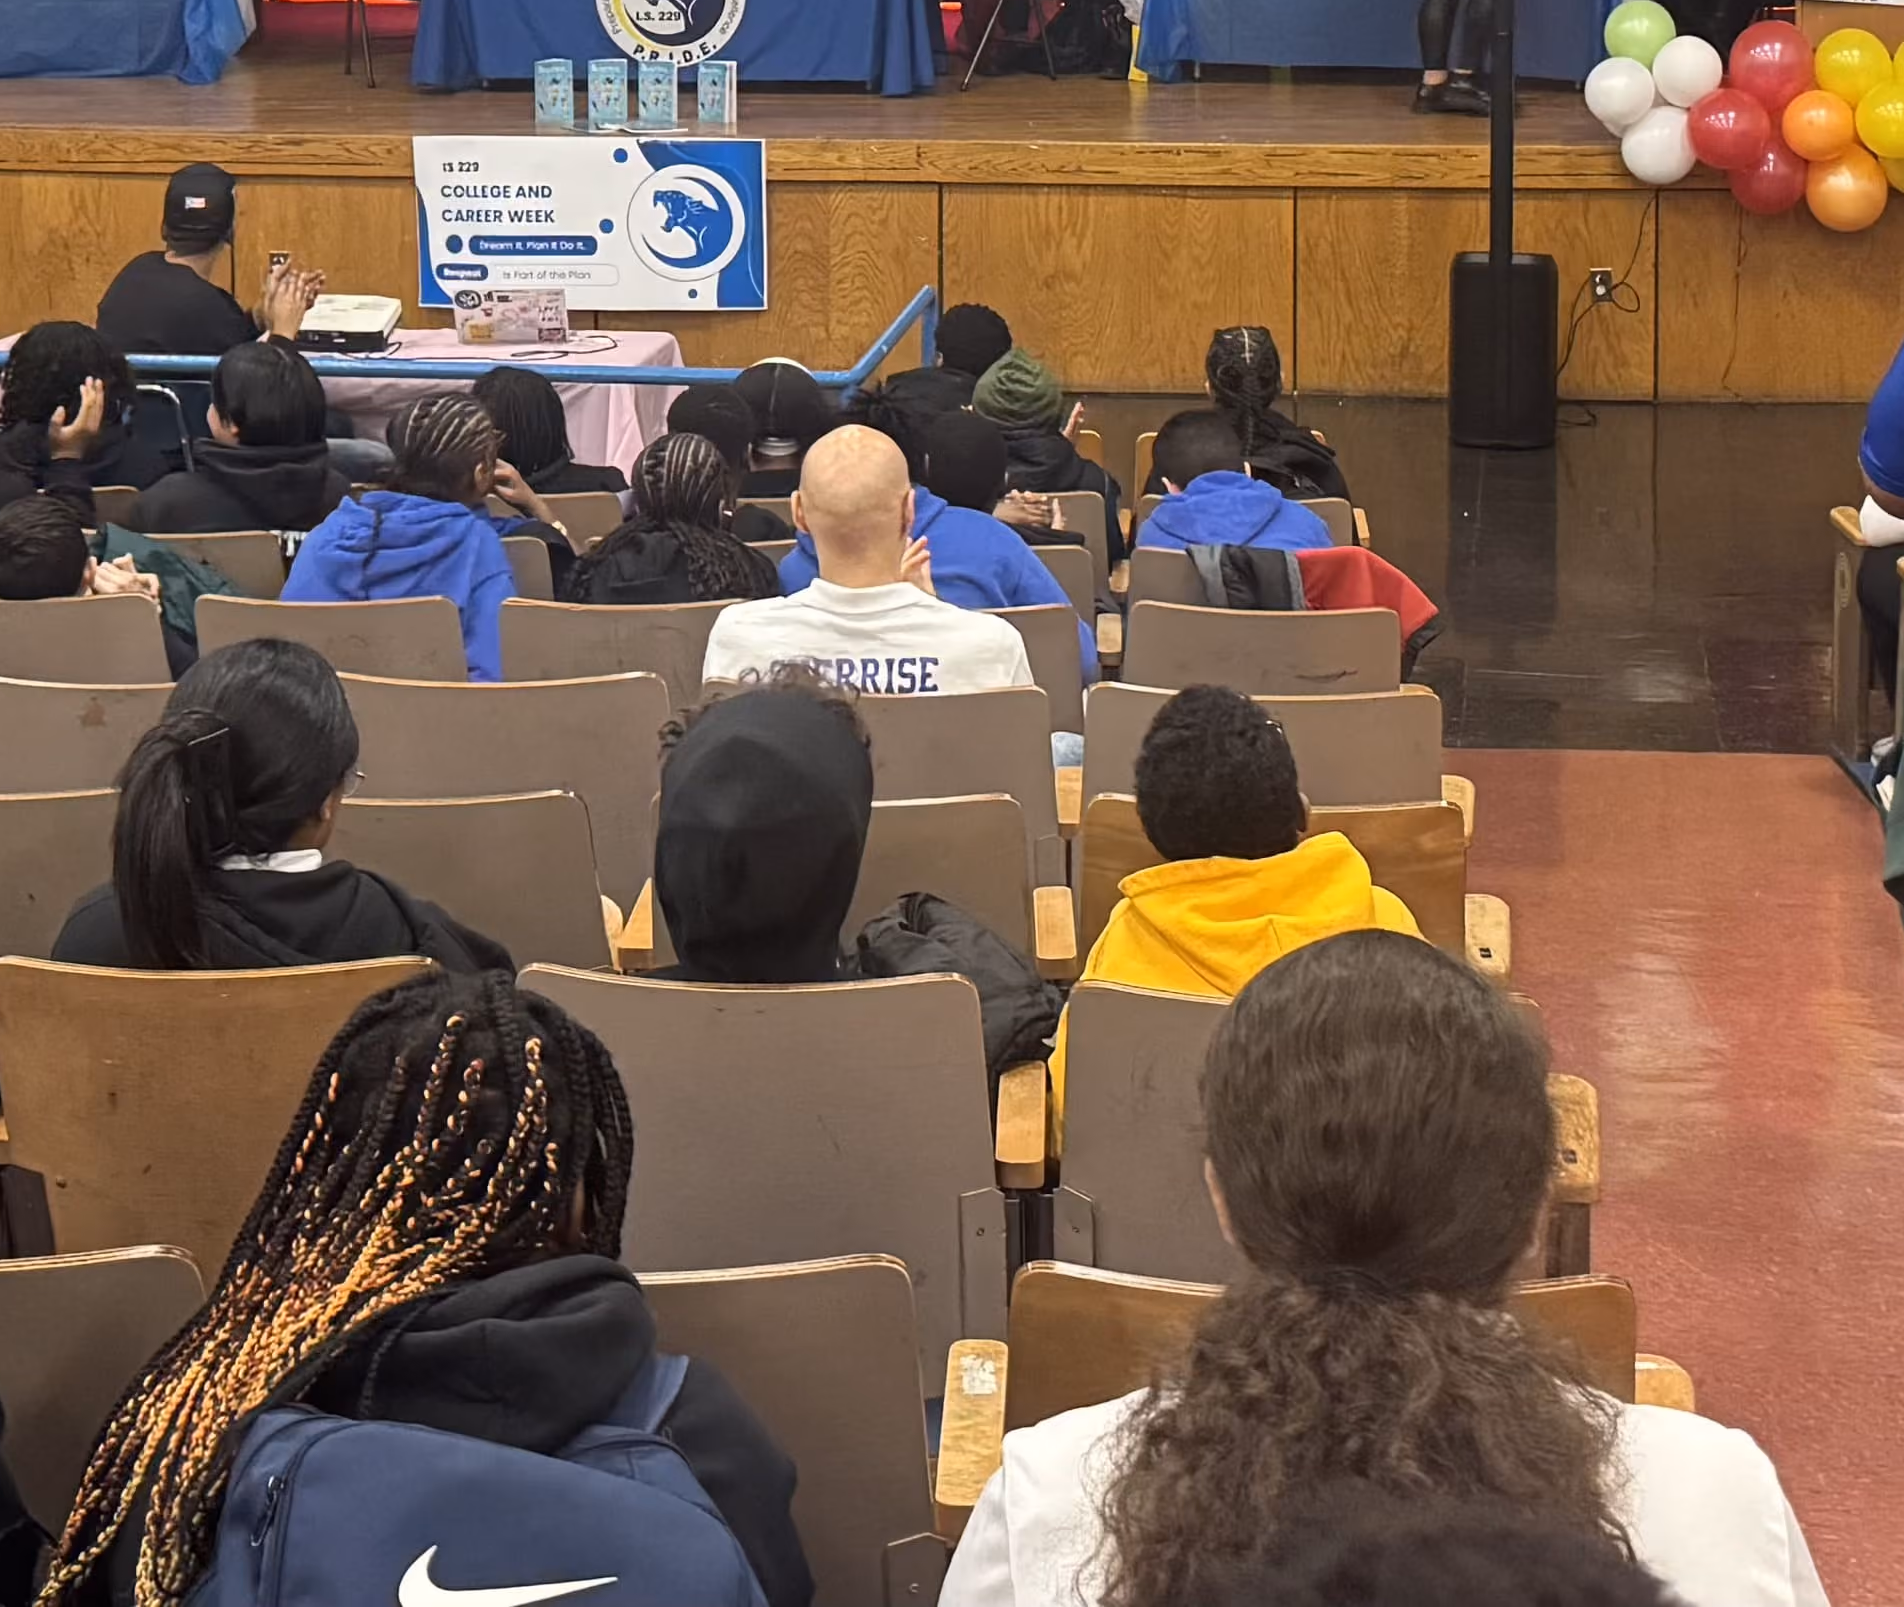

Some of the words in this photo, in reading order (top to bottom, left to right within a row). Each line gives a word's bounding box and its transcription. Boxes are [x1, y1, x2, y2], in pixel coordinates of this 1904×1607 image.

[658, 11, 681, 21] 229
[633, 42, 717, 66] P.RI.D.E.
[443, 162, 454, 172] IS
[458, 161, 479, 172] 229
[441, 185, 511, 199] COLLEGE
[515, 185, 552, 199] AND
[442, 209, 503, 223] CAREER
[508, 209, 555, 223] WEEK
[479, 240, 513, 250] Dream
[526, 240, 549, 250] Plan
[560, 240, 575, 250] Do
[537, 270, 546, 279] of
[548, 270, 565, 279] the
[568, 270, 591, 279] Plan
